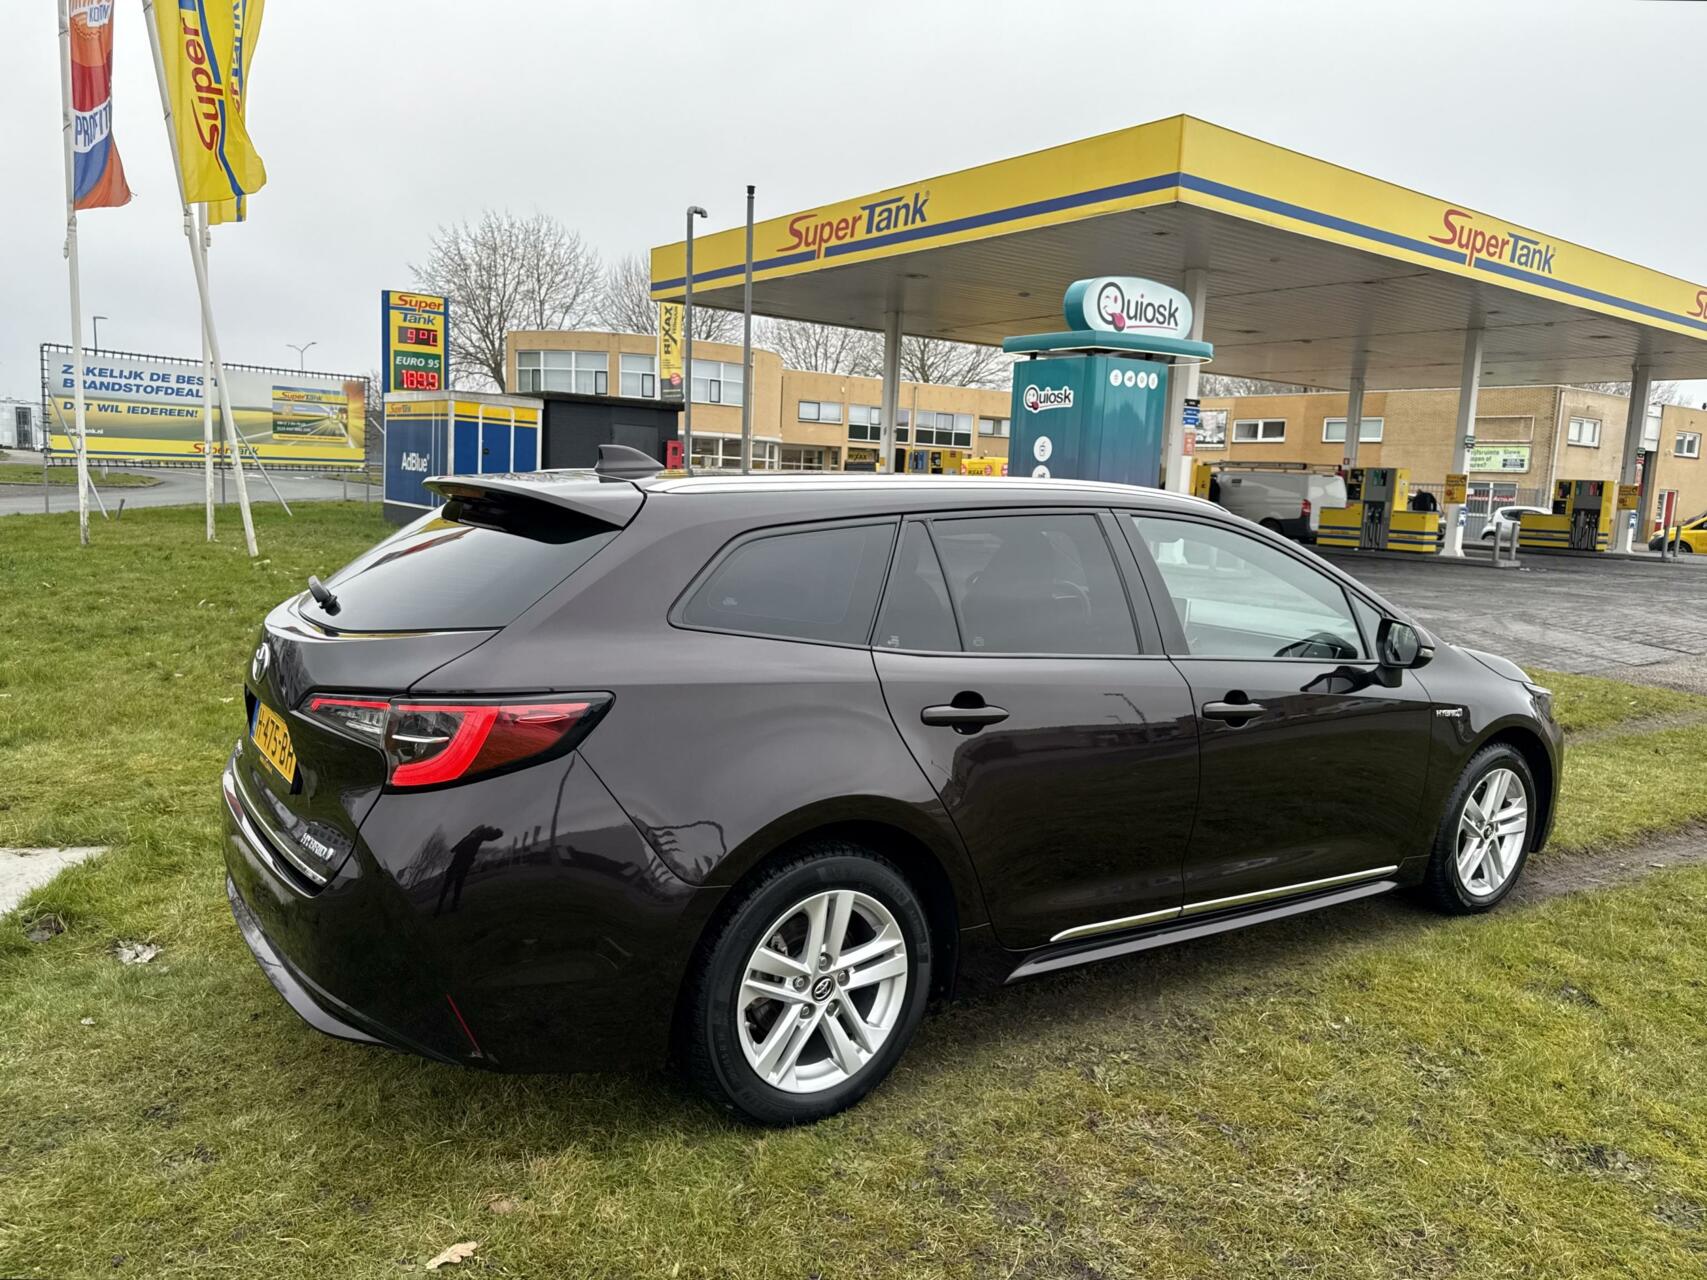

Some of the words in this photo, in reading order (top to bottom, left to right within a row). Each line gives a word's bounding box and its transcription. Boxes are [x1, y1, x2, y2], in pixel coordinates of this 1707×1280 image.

[777, 193, 930, 259] SuperTank
[1428, 209, 1556, 274] SuperTank
[393, 294, 443, 312] Super
[1097, 282, 1179, 331] Quiosk
[400, 312, 436, 326] Tank
[395, 356, 425, 367] EURO
[427, 359, 440, 368] 95
[62, 364, 144, 381] ZKELIJK
[150, 372, 171, 383] DE
[175, 374, 218, 387] BES
[62, 378, 203, 398] BANDSTOFDEAL
[1025, 386, 1072, 410] Quiosk
[63, 402, 93, 411] DT
[98, 403, 123, 414] WIL
[127, 405, 198, 417] IEDEREEN!
[401, 452, 428, 472] AdBlue
